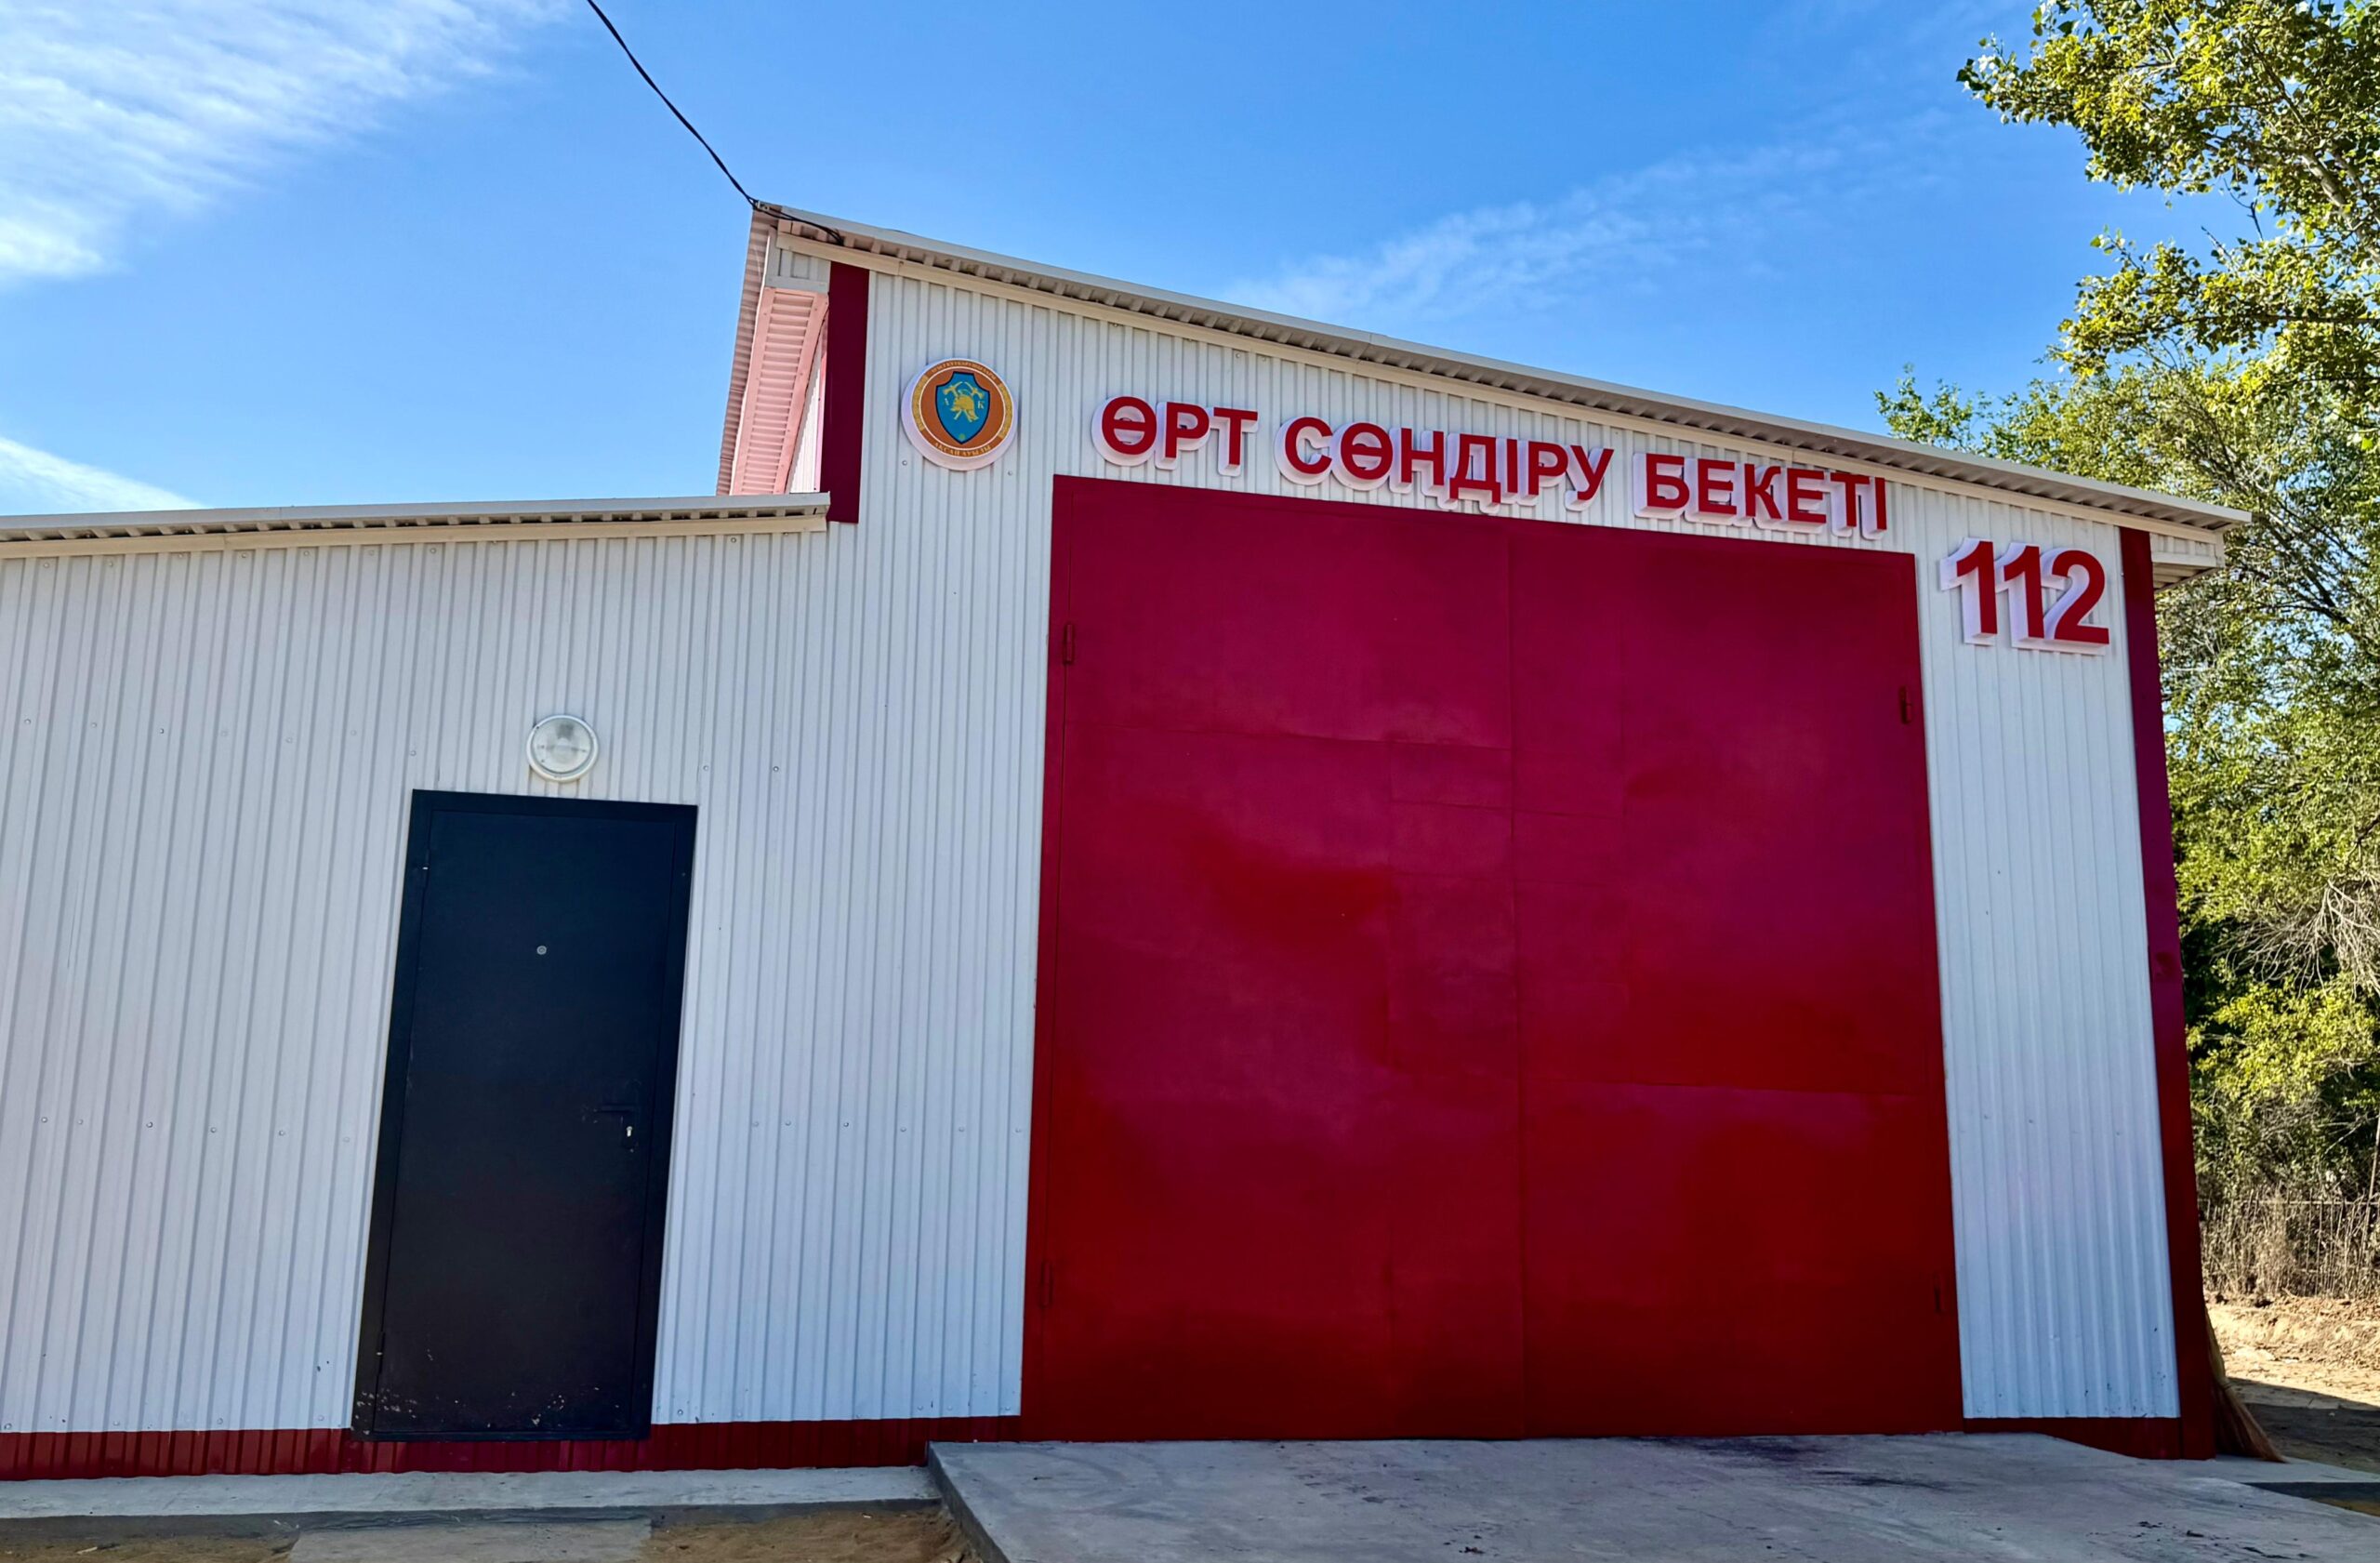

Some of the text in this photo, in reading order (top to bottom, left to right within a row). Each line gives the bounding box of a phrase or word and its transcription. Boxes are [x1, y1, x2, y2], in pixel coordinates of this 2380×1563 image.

[1101, 396, 1888, 531] ӨРТ СӨНДІРУ БЕКЕТІ
[1955, 540, 2110, 645] 112
